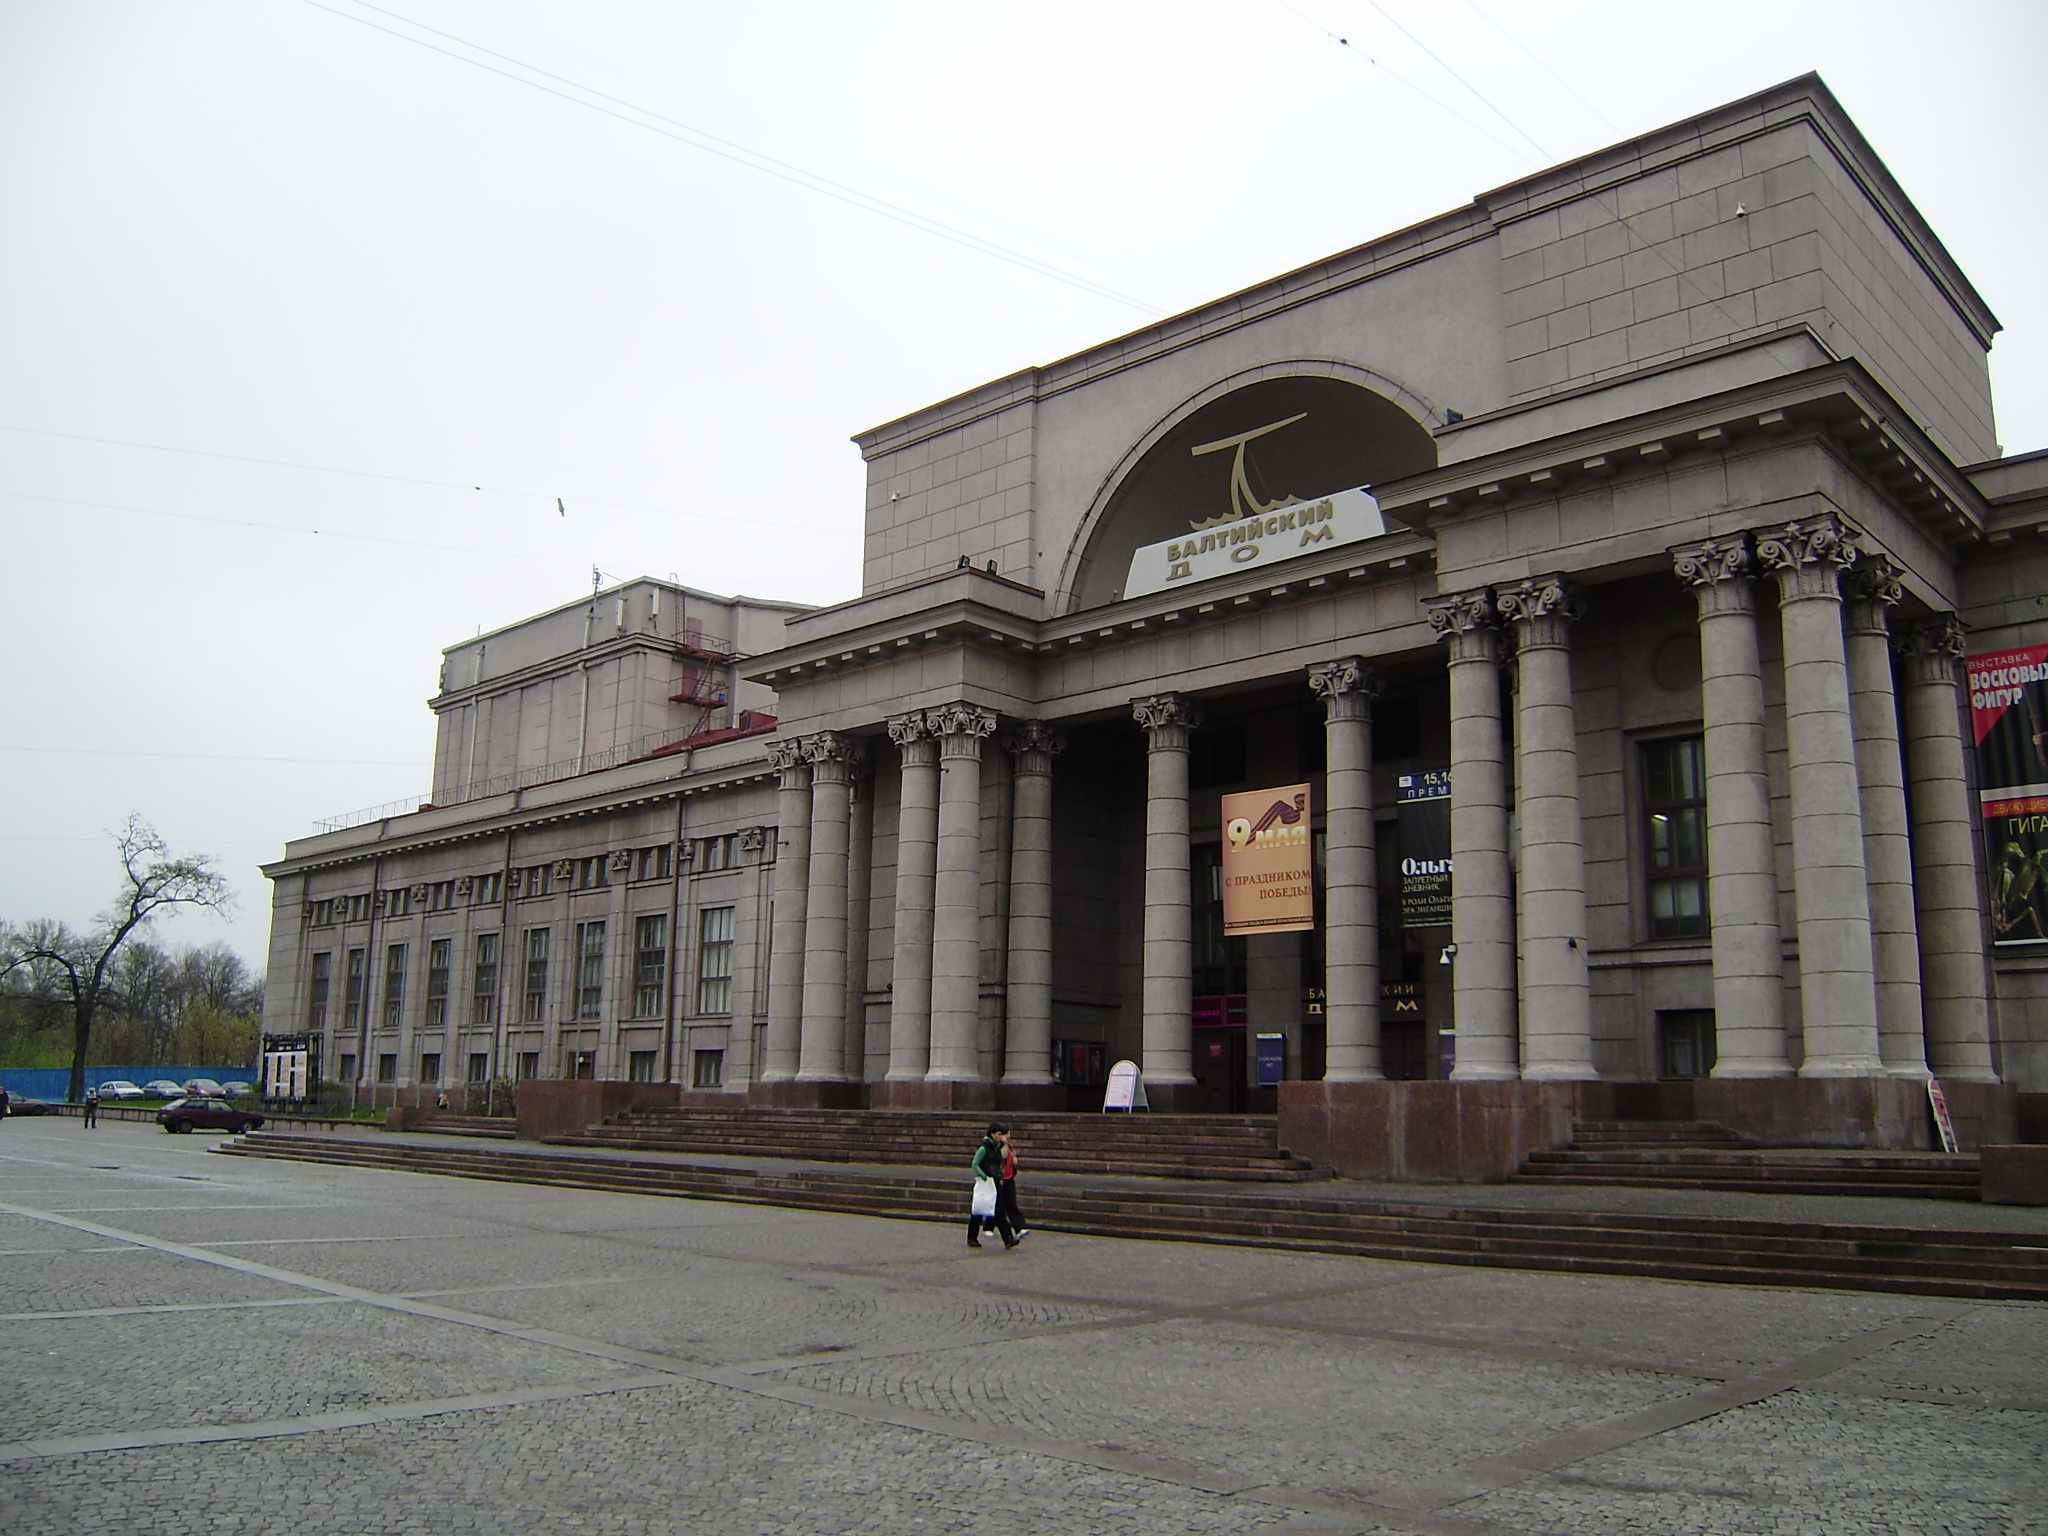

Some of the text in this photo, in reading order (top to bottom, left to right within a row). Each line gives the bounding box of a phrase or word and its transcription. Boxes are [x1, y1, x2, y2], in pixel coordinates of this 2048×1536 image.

[1167, 498, 1333, 562] БАЛТИЙСКИЙ
[1165, 524, 1334, 581] ДОМ
[1968, 653, 2030, 670] ВЫСТАВКА
[1972, 687, 2023, 709] ФИГУР
[1227, 817, 1306, 853] 9 МАЯ
[1225, 869, 1311, 887] С ПРАЗДНИКОМ
[1402, 882, 1440, 893] ДНЕВНИК
